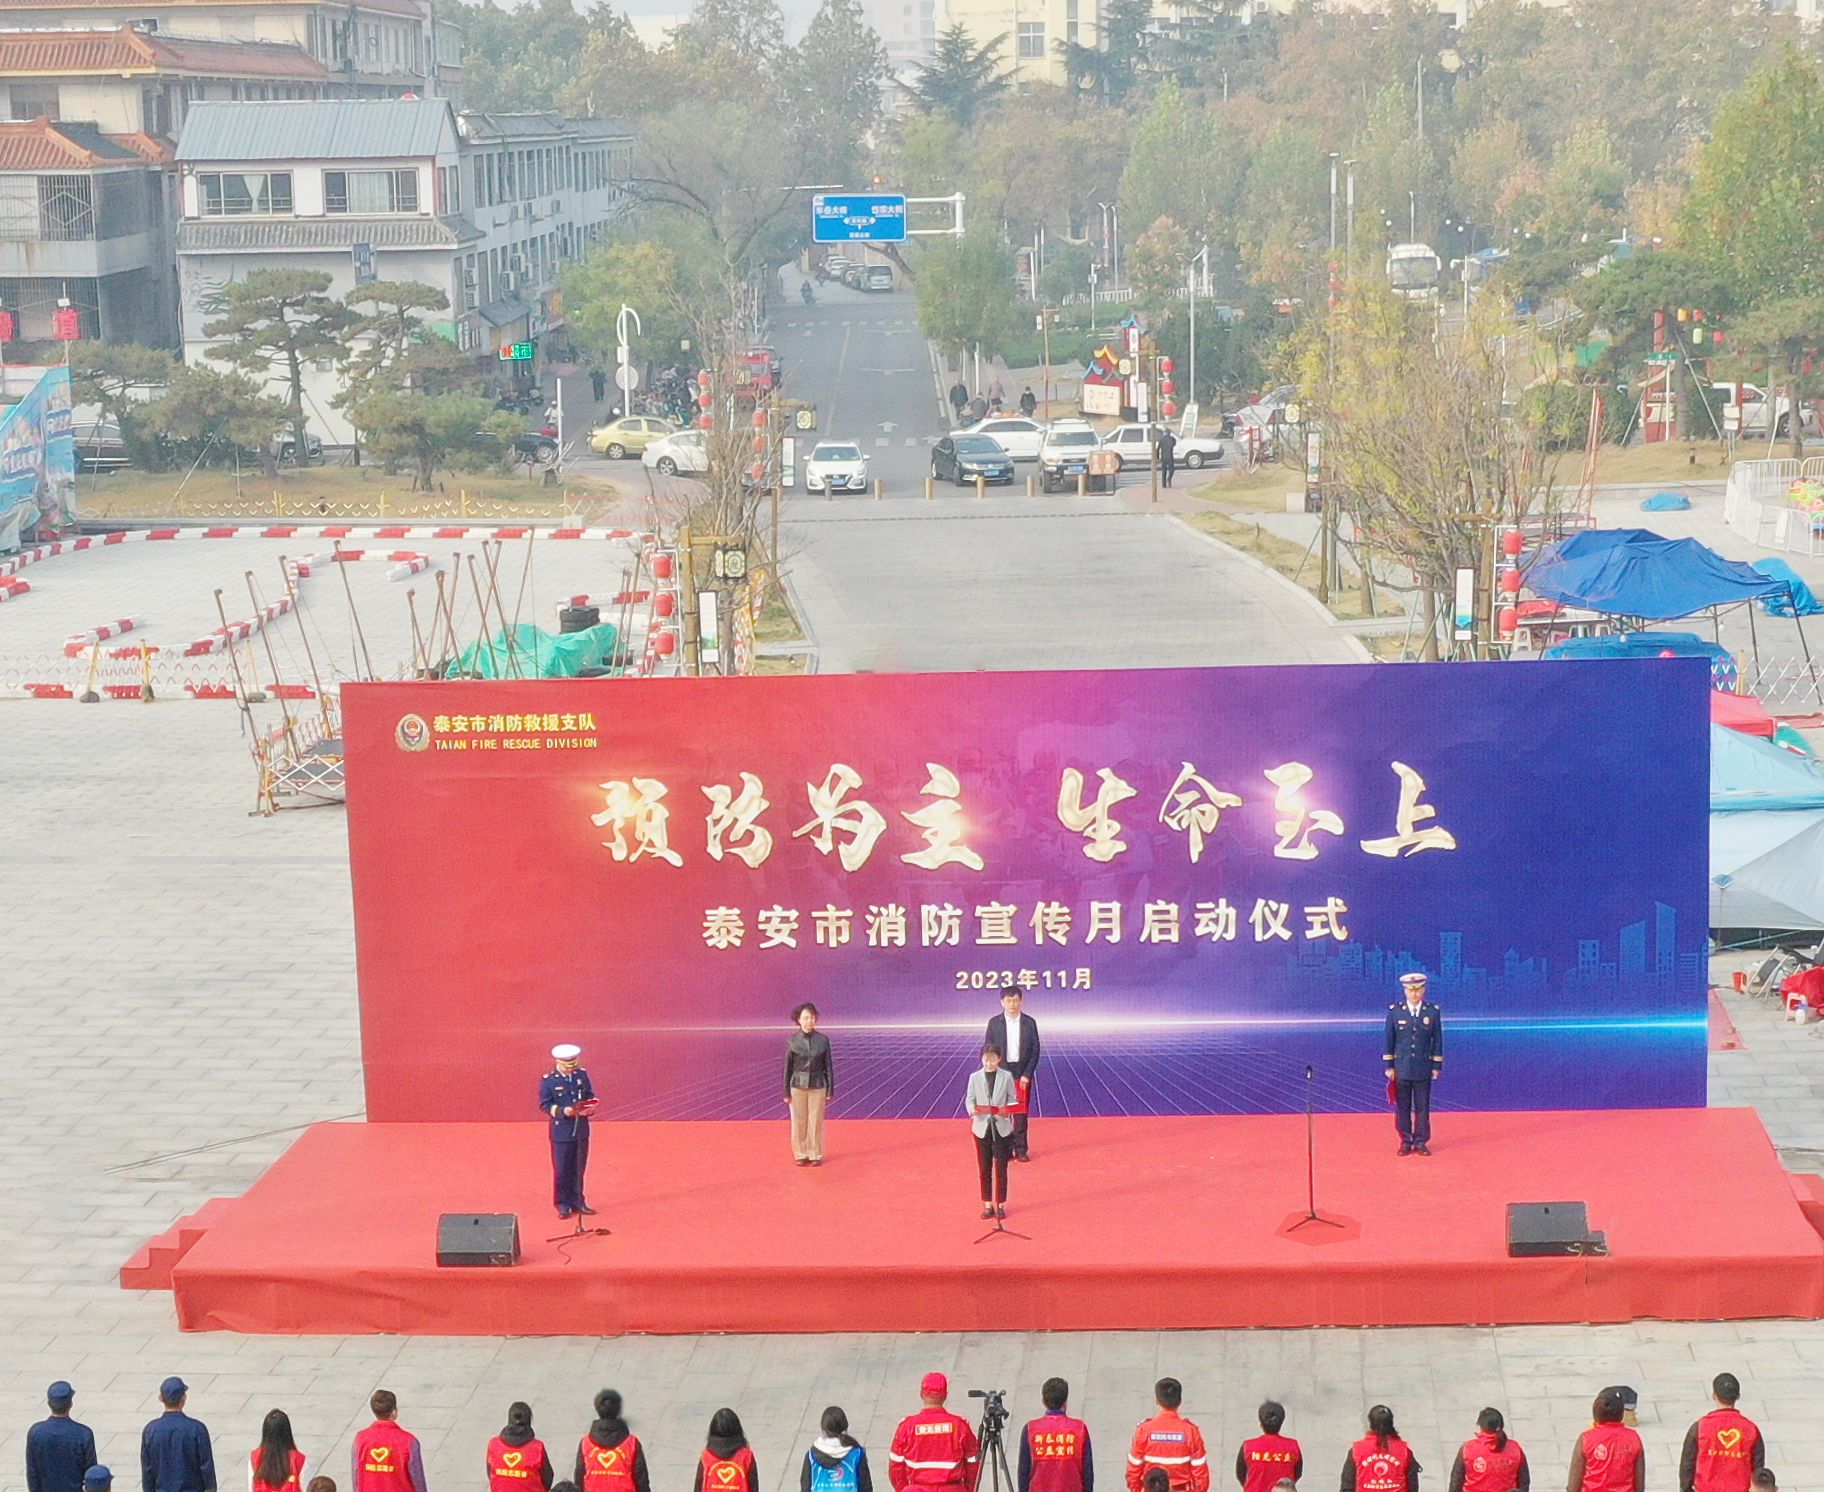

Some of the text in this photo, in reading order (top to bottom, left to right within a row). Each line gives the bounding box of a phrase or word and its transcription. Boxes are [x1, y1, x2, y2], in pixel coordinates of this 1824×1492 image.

[433, 712, 597, 733] 泰安市消防救援支队
[435, 737, 597, 750] TAIAN FIRE RESCUE DIVISION
[591, 759, 1457, 872] 预防为主 生命至上
[702, 897, 1350, 951] 泰安市消防宣传月启动仪式
[955, 968, 1094, 992] 2023年11月
[1033, 1433, 1074, 1444] 新泰消防
[1034, 1446, 1074, 1455] 公益宣传
[1251, 1450, 1293, 1463] 阳光公益
